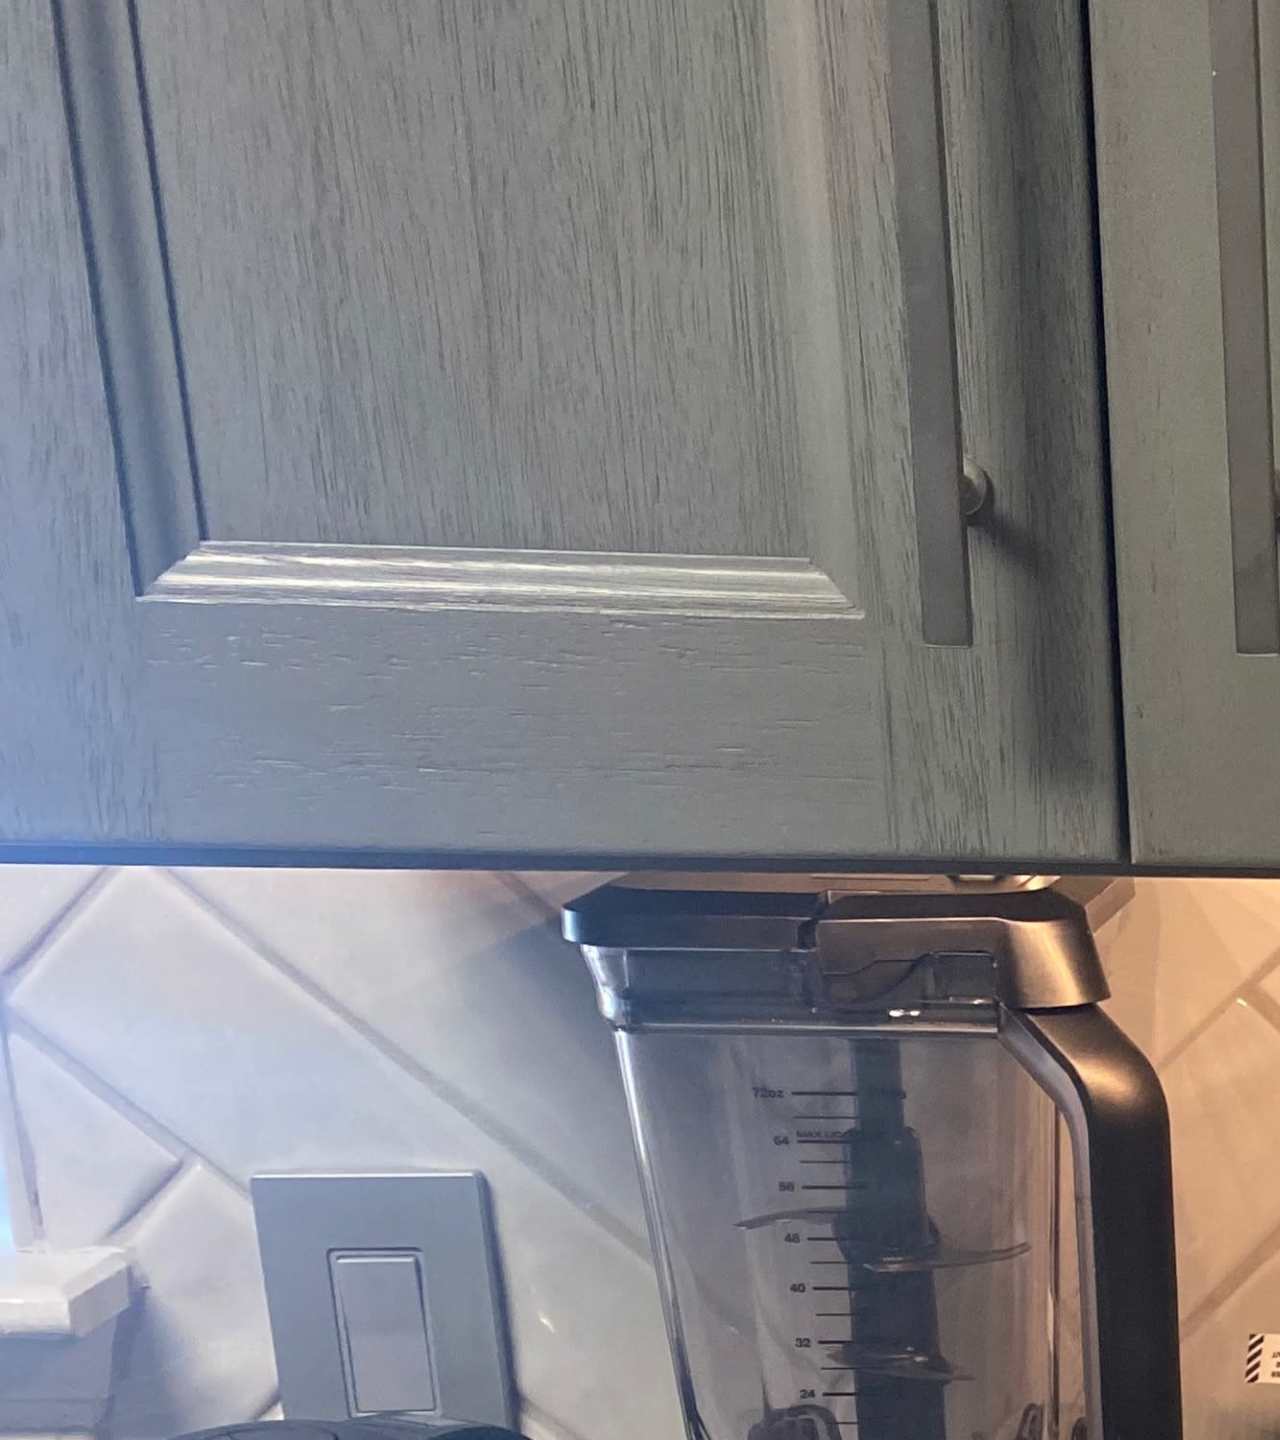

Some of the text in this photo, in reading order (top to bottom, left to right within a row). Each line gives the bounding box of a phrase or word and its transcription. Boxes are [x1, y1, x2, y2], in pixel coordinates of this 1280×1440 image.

[789, 1283, 806, 1294] 40
[794, 1338, 812, 1348] 32
[799, 1389, 816, 1399] 24
